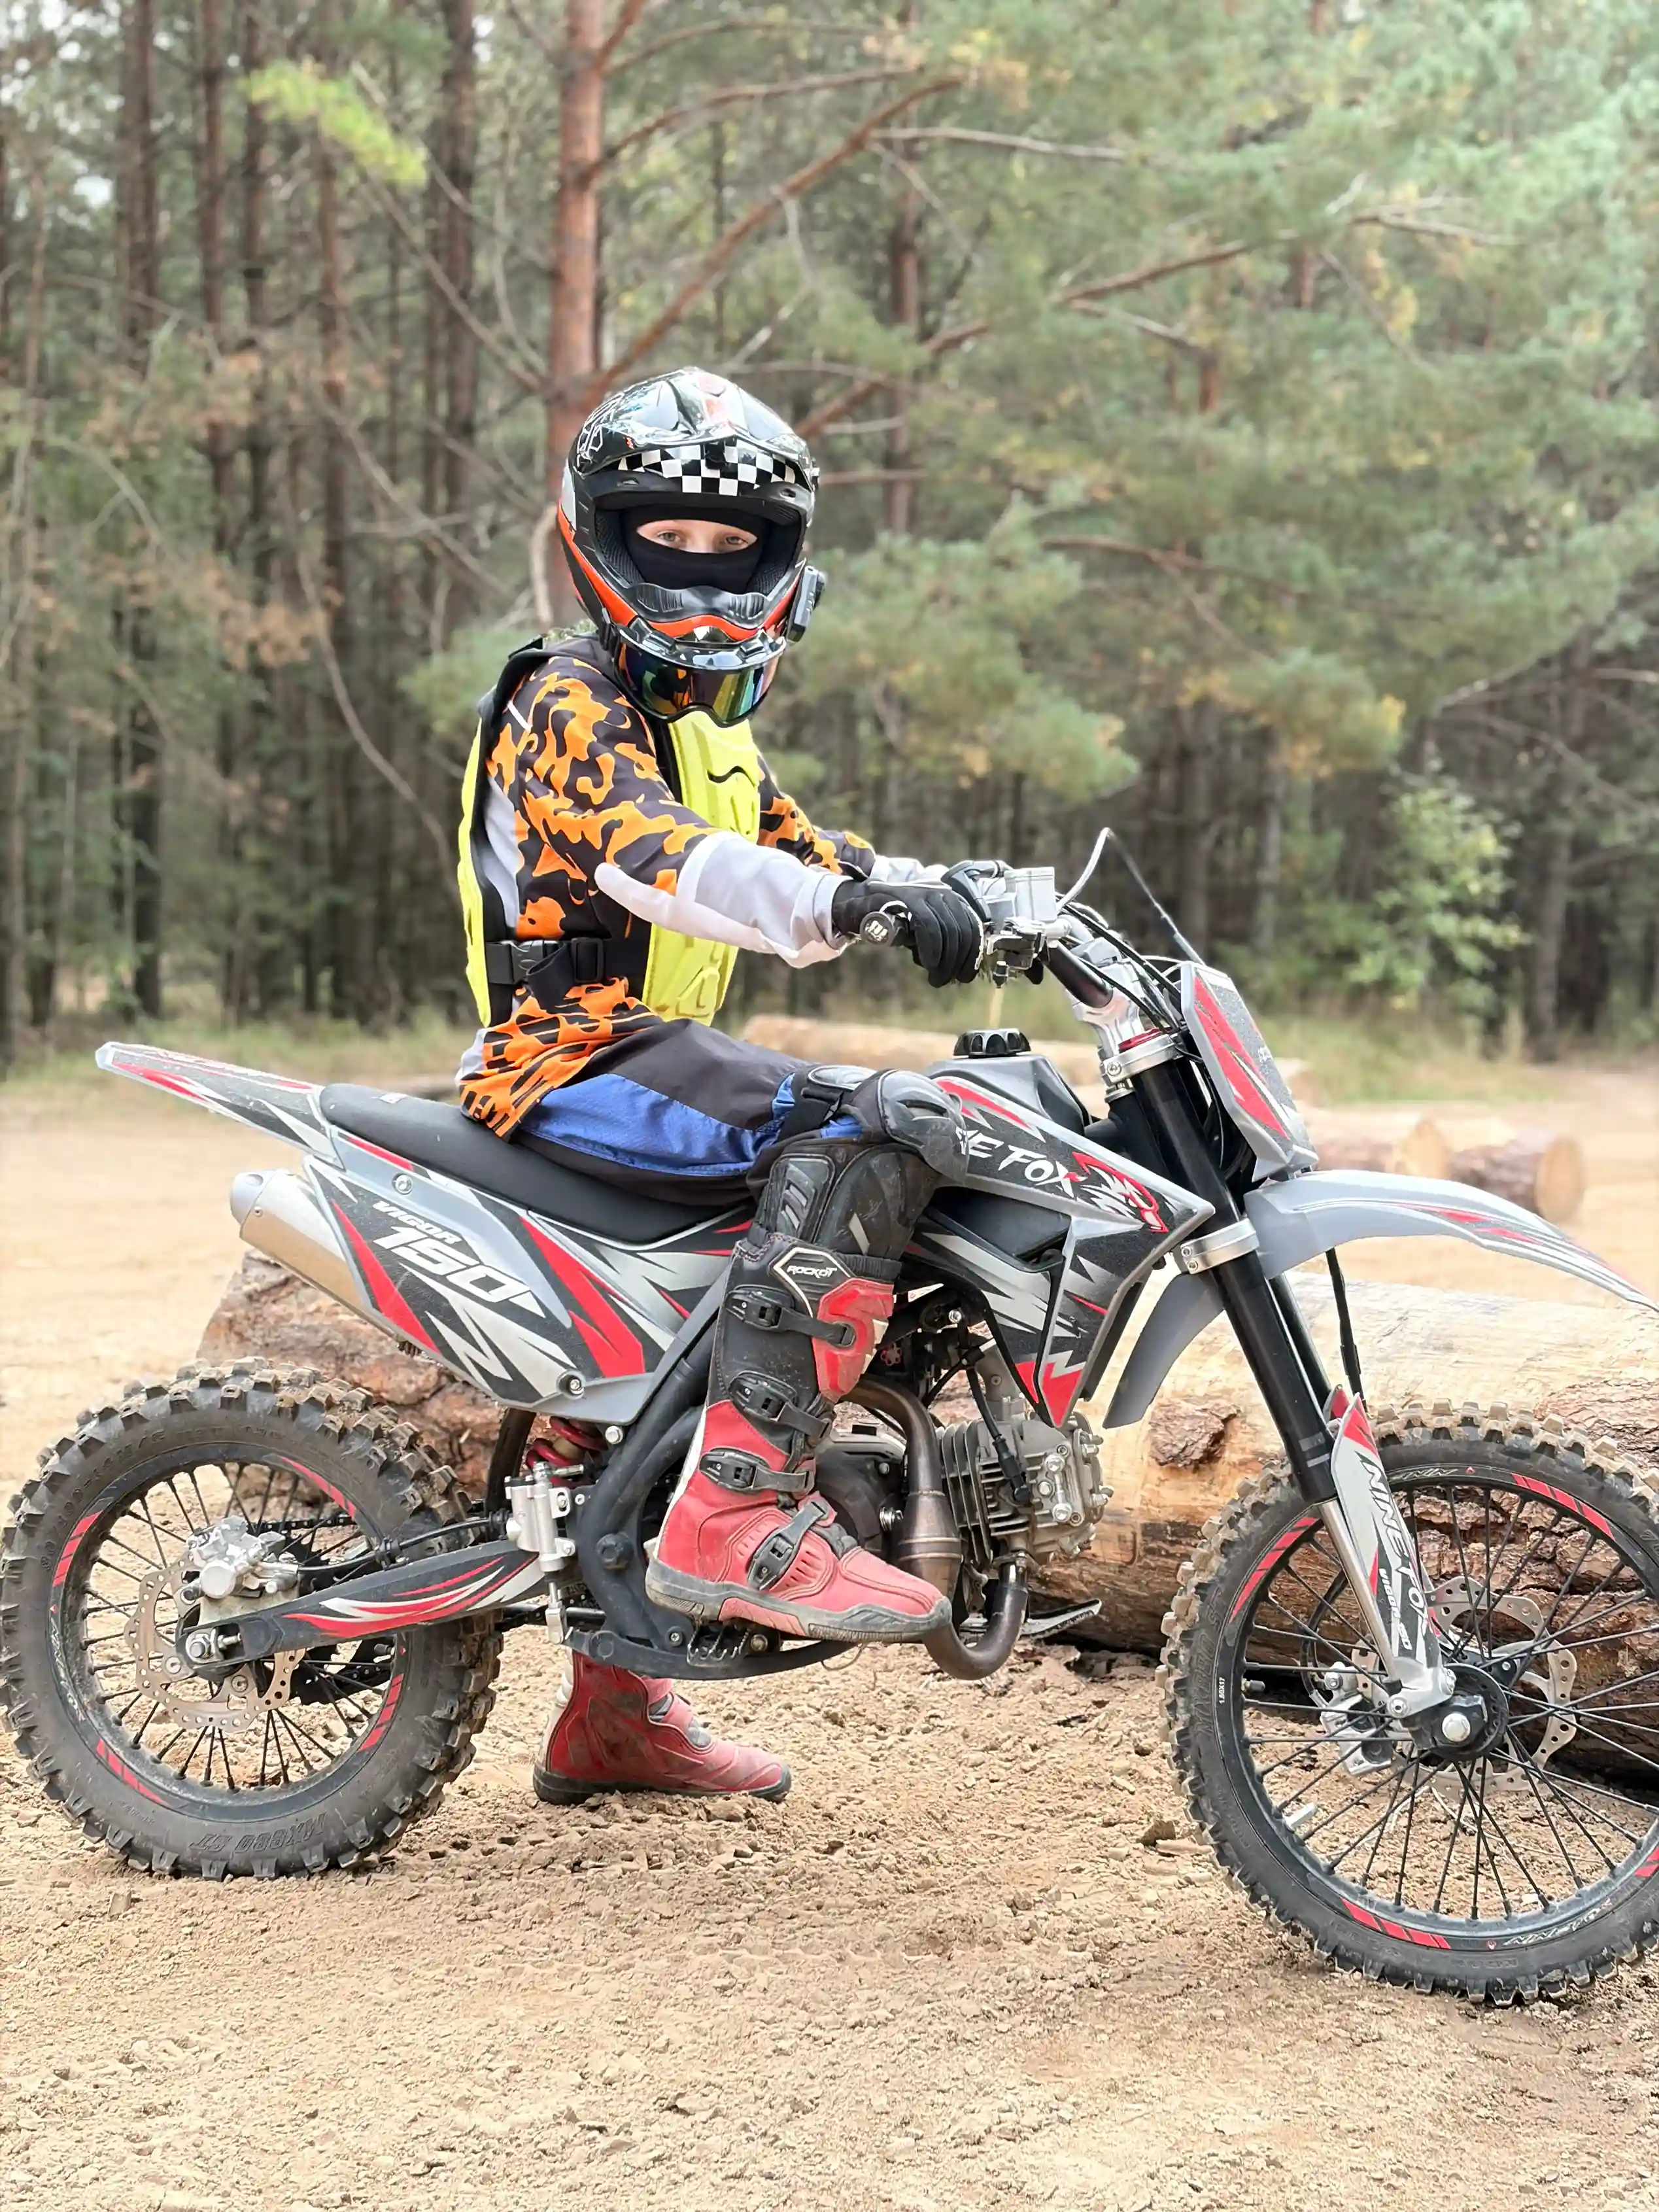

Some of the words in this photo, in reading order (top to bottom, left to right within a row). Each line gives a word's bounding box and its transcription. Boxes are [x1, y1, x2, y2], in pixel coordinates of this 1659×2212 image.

[998, 1145, 1076, 1198] FOX
[373, 1200, 462, 1245] VIGOR
[373, 1226, 531, 1304] 150
[1360, 1459, 1410, 1558] NINE
[1395, 1561, 1433, 1636] FOX
[1378, 1568, 1401, 1619] VIGOR
